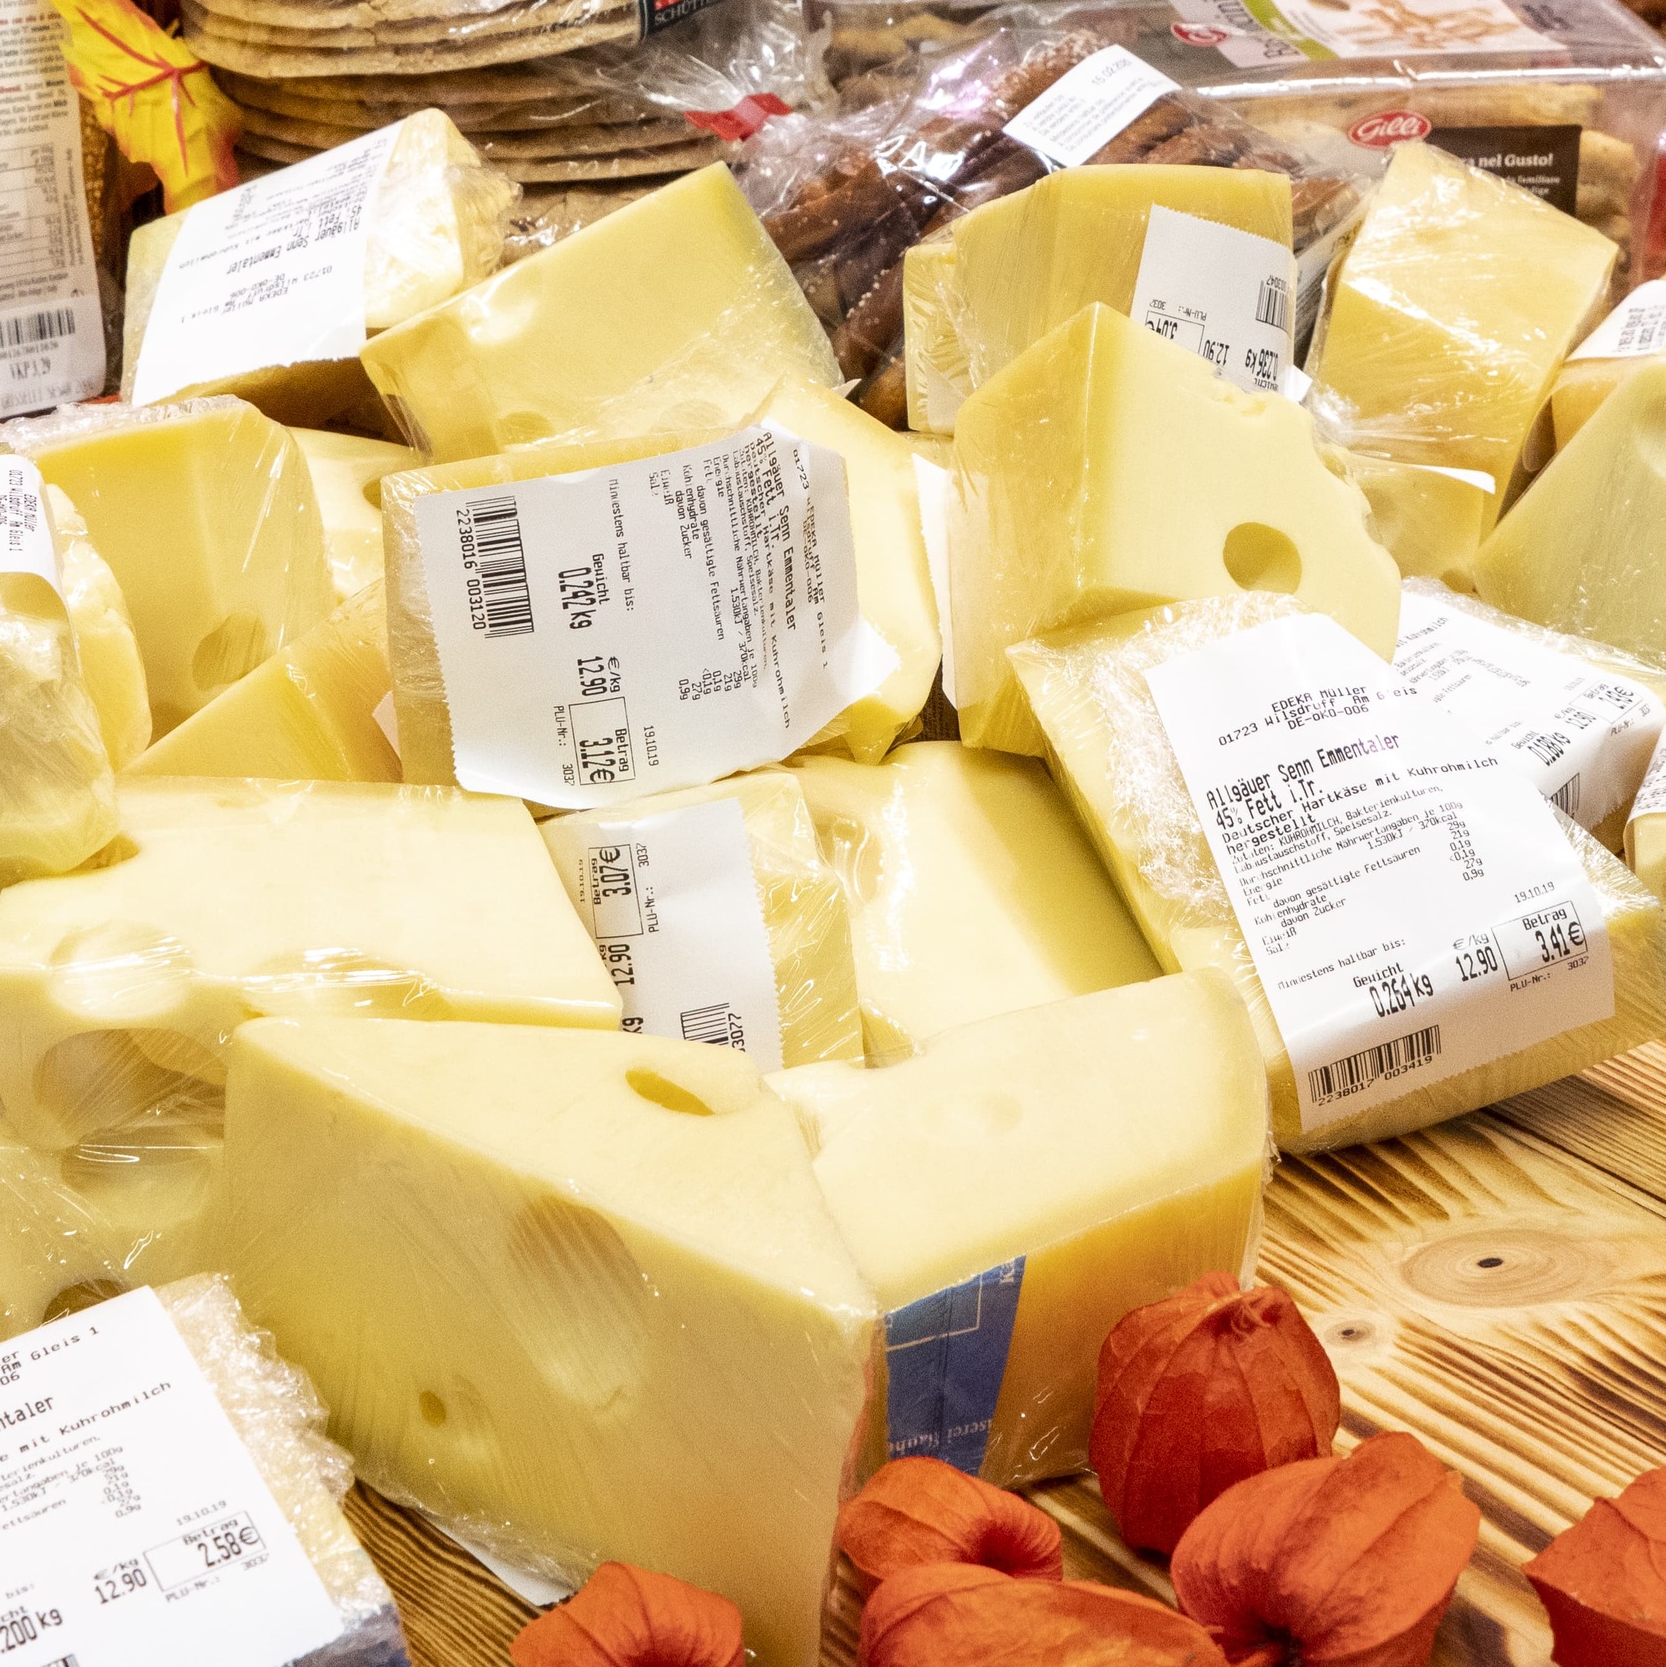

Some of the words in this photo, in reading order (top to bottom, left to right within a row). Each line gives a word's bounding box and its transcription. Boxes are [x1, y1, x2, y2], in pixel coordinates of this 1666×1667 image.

[1355, 115, 1431, 142] Gilli
[1478, 155, 1503, 168] nel
[1504, 152, 1554, 168] Gusto!
[762, 468, 776, 505] Fett
[763, 433, 784, 498] Allgäuer
[778, 506, 790, 541] Senn
[784, 547, 795, 630] Emmentaler
[457, 506, 477, 569] 2238016
[467, 579, 486, 629] 003120
[558, 567, 596, 609] 0.242
[570, 610, 596, 629] kg
[578, 656, 607, 696] 12.90
[593, 554, 610, 604] Gewicht
[608, 657, 621, 692] €/kg
[615, 728, 630, 772] Betrag
[1219, 723, 1257, 745] 01723
[1353, 692, 1369, 707] Am
[1272, 693, 1312, 715] EDEKA
[1319, 684, 1367, 699] Müller
[554, 706, 567, 746] PLU-Nr.:
[644, 726, 659, 766] 19.10.19
[579, 738, 618, 785] 3.12€
[1207, 774, 1270, 809] Allgäuer
[1278, 759, 1314, 782] Senn
[1317, 736, 1398, 768] Emmentaler
[1222, 810, 1295, 843] Deutscher
[1302, 784, 1366, 812] Hartkäse
[1375, 773, 1399, 786] mit
[1408, 758, 1497, 776] Kuhrohmilch
[1245, 791, 1281, 819] Fett
[1288, 779, 1322, 803] i.Tr.
[1226, 814, 1315, 854] hergestellt
[592, 858, 601, 904] Betrag
[596, 846, 631, 896] 3.07€
[645, 887, 659, 933] PLU-Nr.:
[1515, 882, 1554, 903] 19.10.19
[608, 944, 634, 985] 12.90
[1353, 963, 1403, 987] Gewicht
[1453, 934, 1489, 950] €/kg
[1523, 909, 1567, 930] Betrag
[1370, 975, 1415, 1017] 0.264
[1410, 974, 1433, 997] kg
[1456, 946, 1498, 981] 12.90
[1535, 922, 1588, 963] 3.41€
[1510, 973, 1550, 992] PLU-Nr.:
[1381, 1053, 1432, 1080] 003419
[31, 1336, 80, 1360] Gleis
[20, 1436, 47, 1452] mit
[59, 1383, 170, 1435] Kuhrohmilch
[36, 1609, 62, 1628] kg
[95, 1569, 146, 1604] 12.90
[198, 1527, 257, 1567] 2.58€
